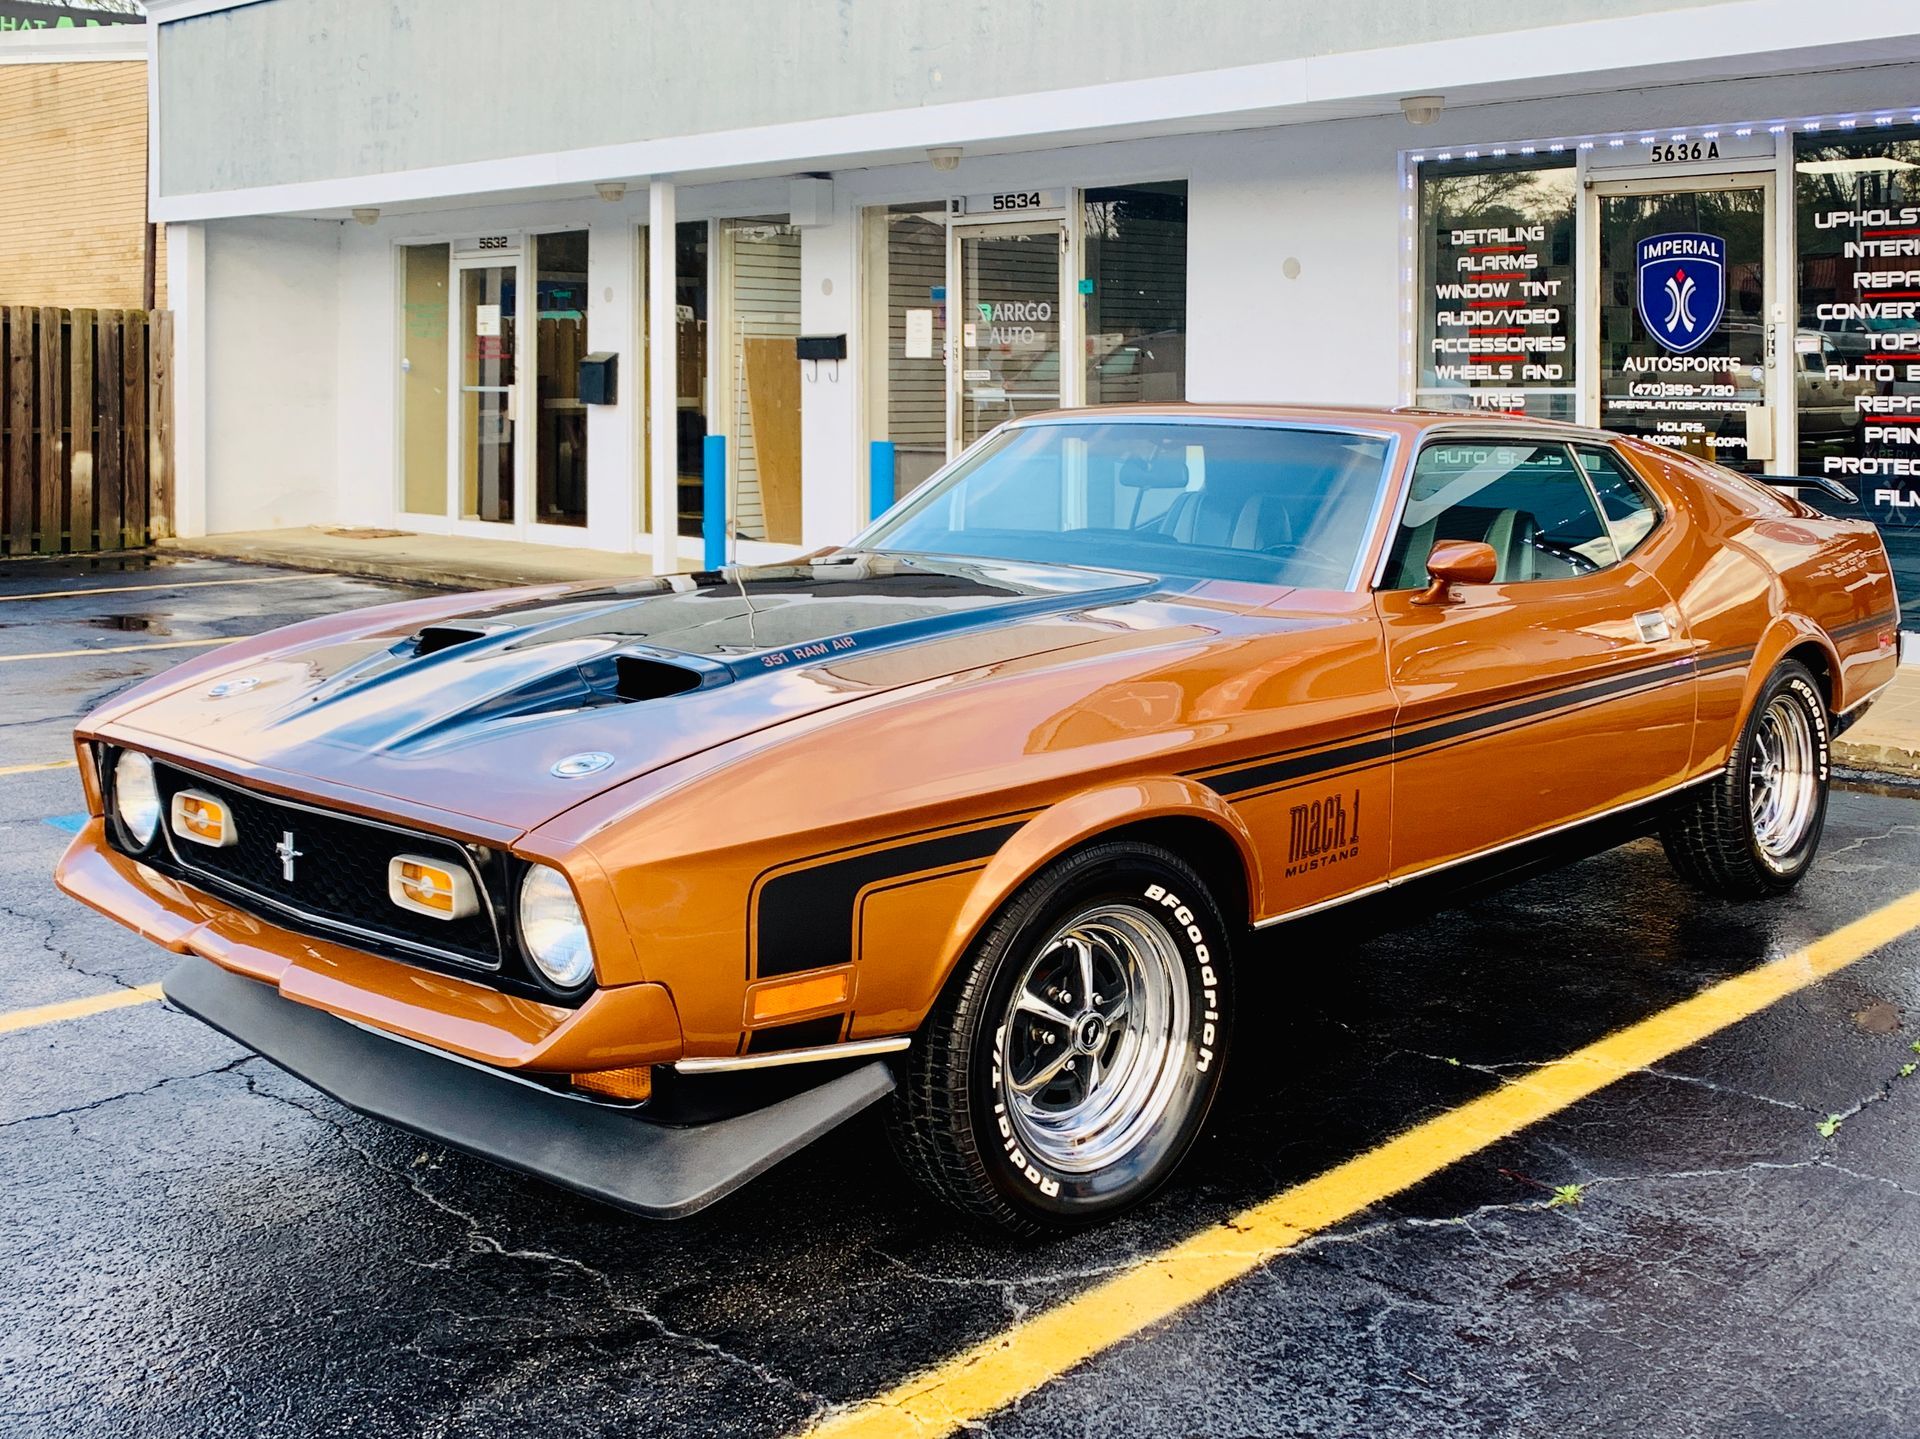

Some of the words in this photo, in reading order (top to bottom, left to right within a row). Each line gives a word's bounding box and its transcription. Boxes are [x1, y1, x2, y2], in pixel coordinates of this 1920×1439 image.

[1651, 143, 1701, 162] 5636
[1708, 142, 1719, 158] A
[993, 192, 1041, 210] 5634
[479, 236, 507, 249] 5632
[1451, 226, 1545, 246] DETAILING
[1643, 239, 1720, 260] IMPERIAL
[1844, 239, 1920, 258] INTERI
[1457, 254, 1539, 272] ALARMS
[1435, 282, 1511, 300] WINDOW
[1519, 280, 1562, 297] TINT
[1437, 308, 1560, 326] AUDIO/VIDEO
[1816, 301, 1920, 320] CONVER
[989, 326, 1034, 345] AUTO
[1431, 336, 1566, 353] ACCESSORIES
[1767, 324, 1775, 357] PULL
[1864, 333, 1920, 351] TOP
[1435, 365, 1513, 380] WHEELS
[1522, 364, 1563, 380] AND
[1622, 356, 1741, 373] AUTOSPORTS
[1824, 364, 1895, 382] AUTO
[1628, 381, 1735, 397] (470)359-7130
[1469, 392, 1526, 408] TIRES
[1656, 422, 1706, 433] HOURS:
[1434, 451, 1488, 464] AUTO
[761, 652, 789, 668] 351
[792, 643, 829, 660] RAM
[832, 636, 857, 651] AIR
[1285, 846, 1359, 878] MUSTANG
[1144, 884, 1219, 1073] BFGoodrich
[994, 1103, 1060, 1198] Radial
